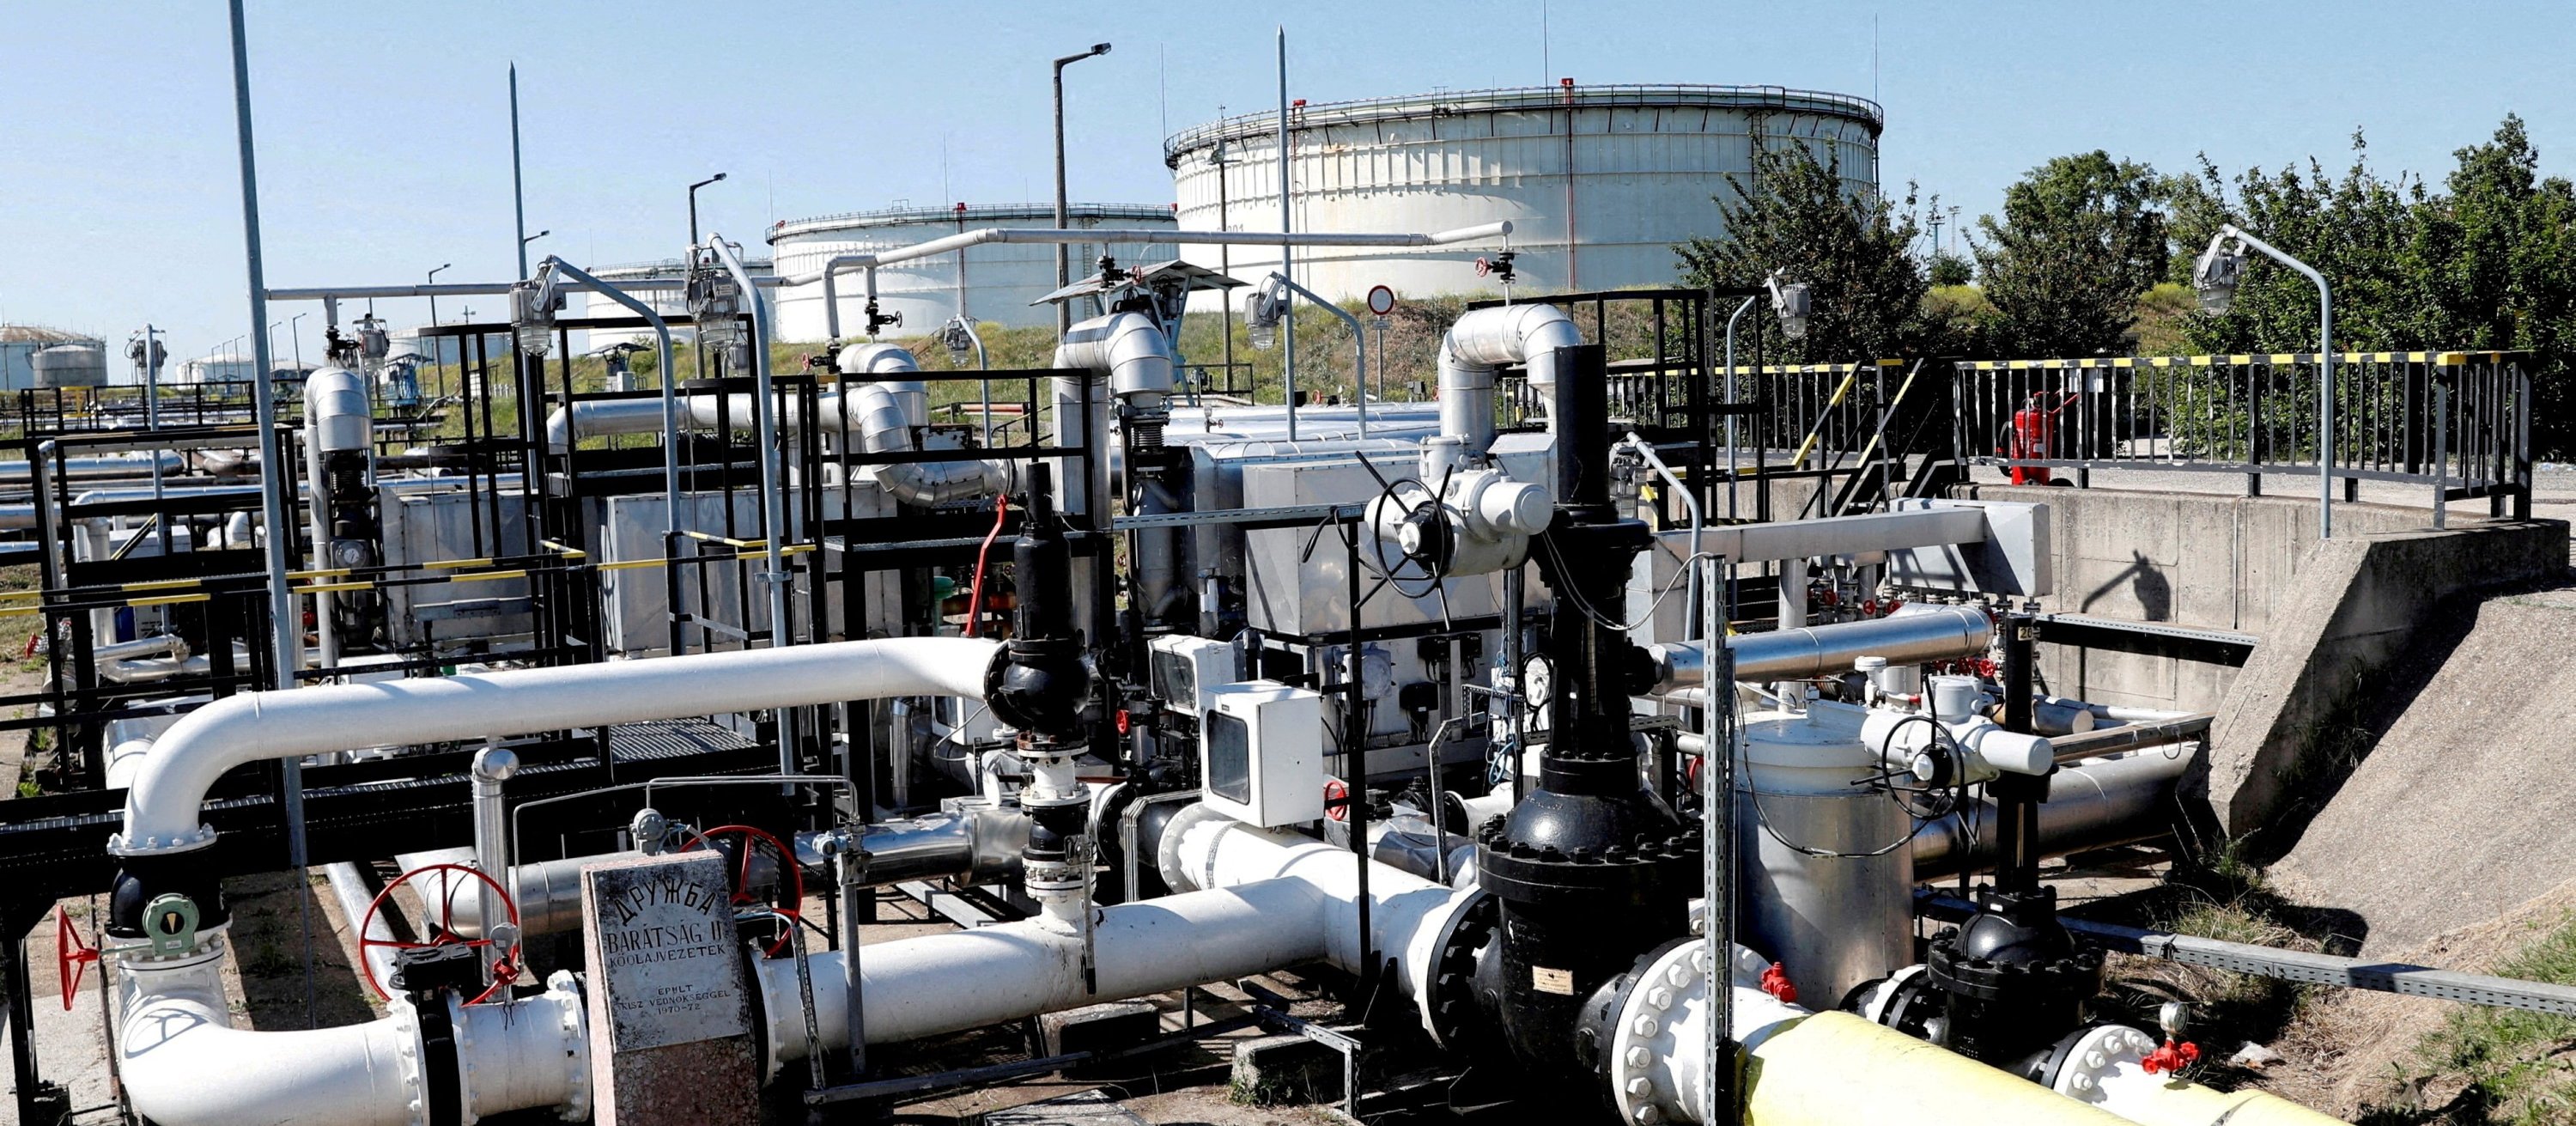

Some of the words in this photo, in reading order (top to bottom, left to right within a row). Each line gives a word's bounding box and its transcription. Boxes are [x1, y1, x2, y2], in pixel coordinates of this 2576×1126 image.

[614, 878, 716, 927] ДРУЖБА
[606, 920, 702, 954] BARÁTSÁG
[711, 920, 721, 941] II
[658, 1003, 701, 1015] 1970-72
